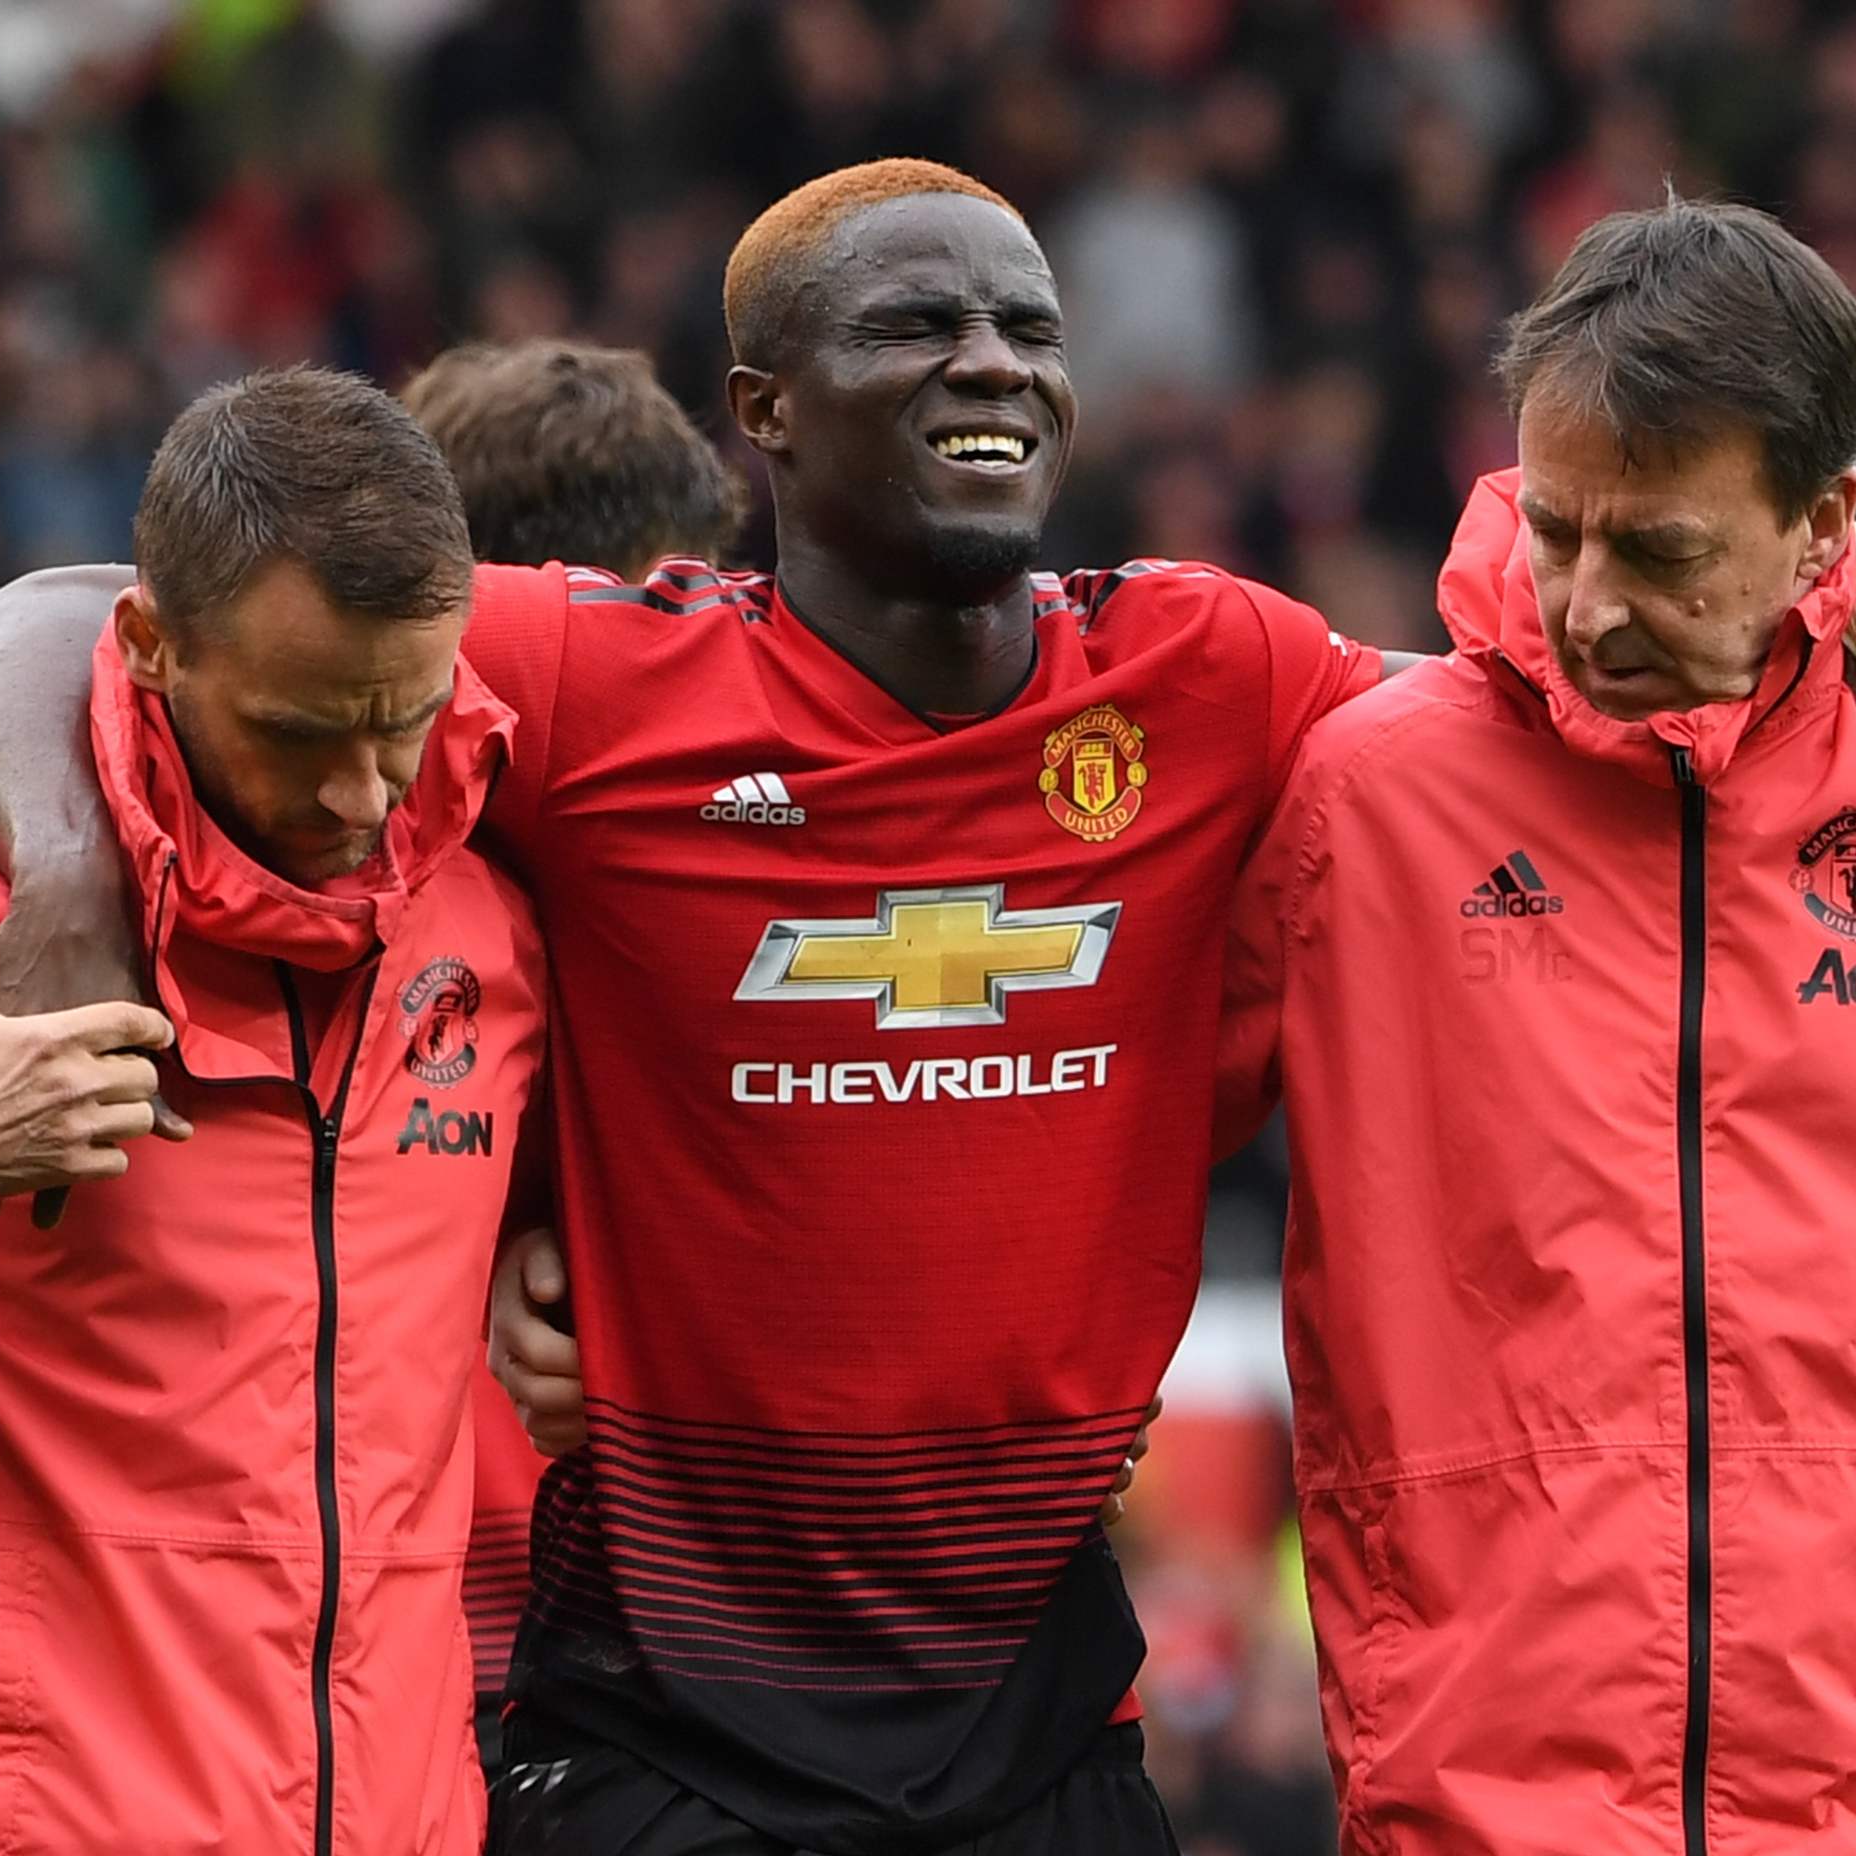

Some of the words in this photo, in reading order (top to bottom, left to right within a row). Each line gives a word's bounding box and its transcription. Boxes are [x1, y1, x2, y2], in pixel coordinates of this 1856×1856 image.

[1050, 712, 1136, 758] MANCHESTER
[699, 798, 806, 826] adidas
[1064, 806, 1128, 833] UNITED
[1460, 888, 1564, 917] adidas
[731, 1043, 1118, 1105] CHEVROLET
